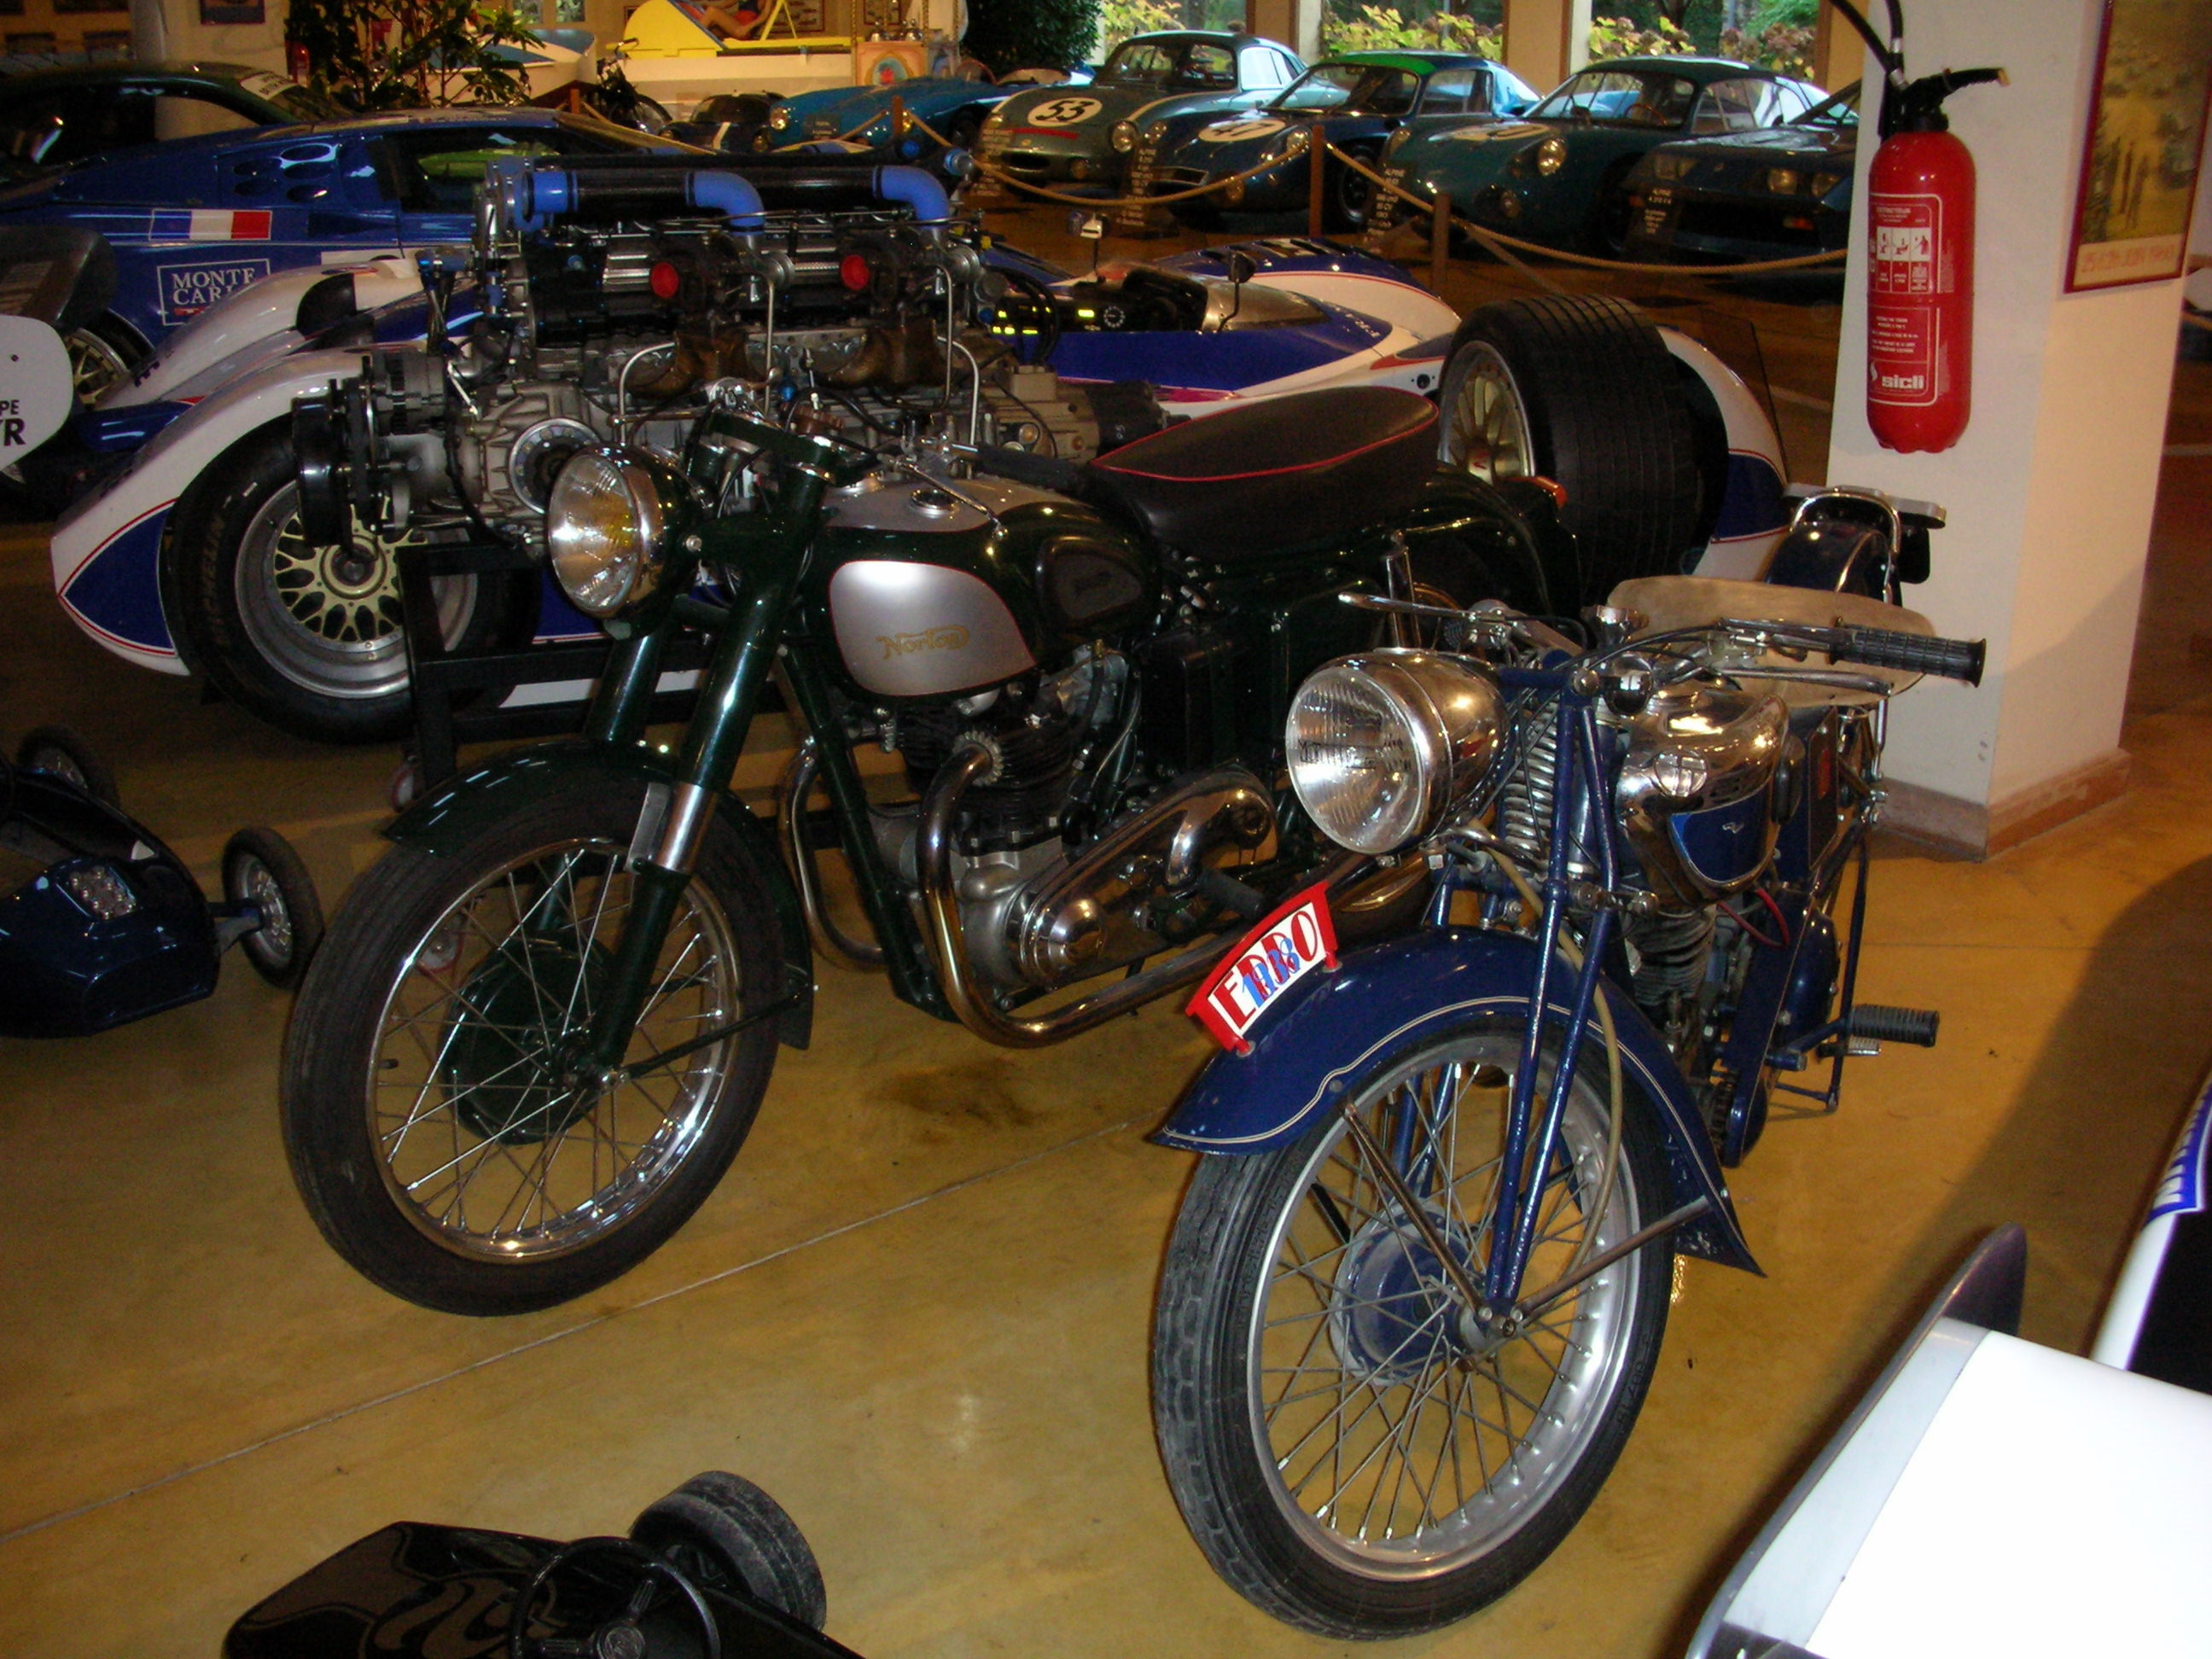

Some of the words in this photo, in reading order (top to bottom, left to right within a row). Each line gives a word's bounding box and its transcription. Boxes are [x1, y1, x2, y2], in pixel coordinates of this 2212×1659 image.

[1035, 99, 1095, 122] 53
[1881, 374, 1924, 389] sicli
[875, 624, 970, 660] Norton
